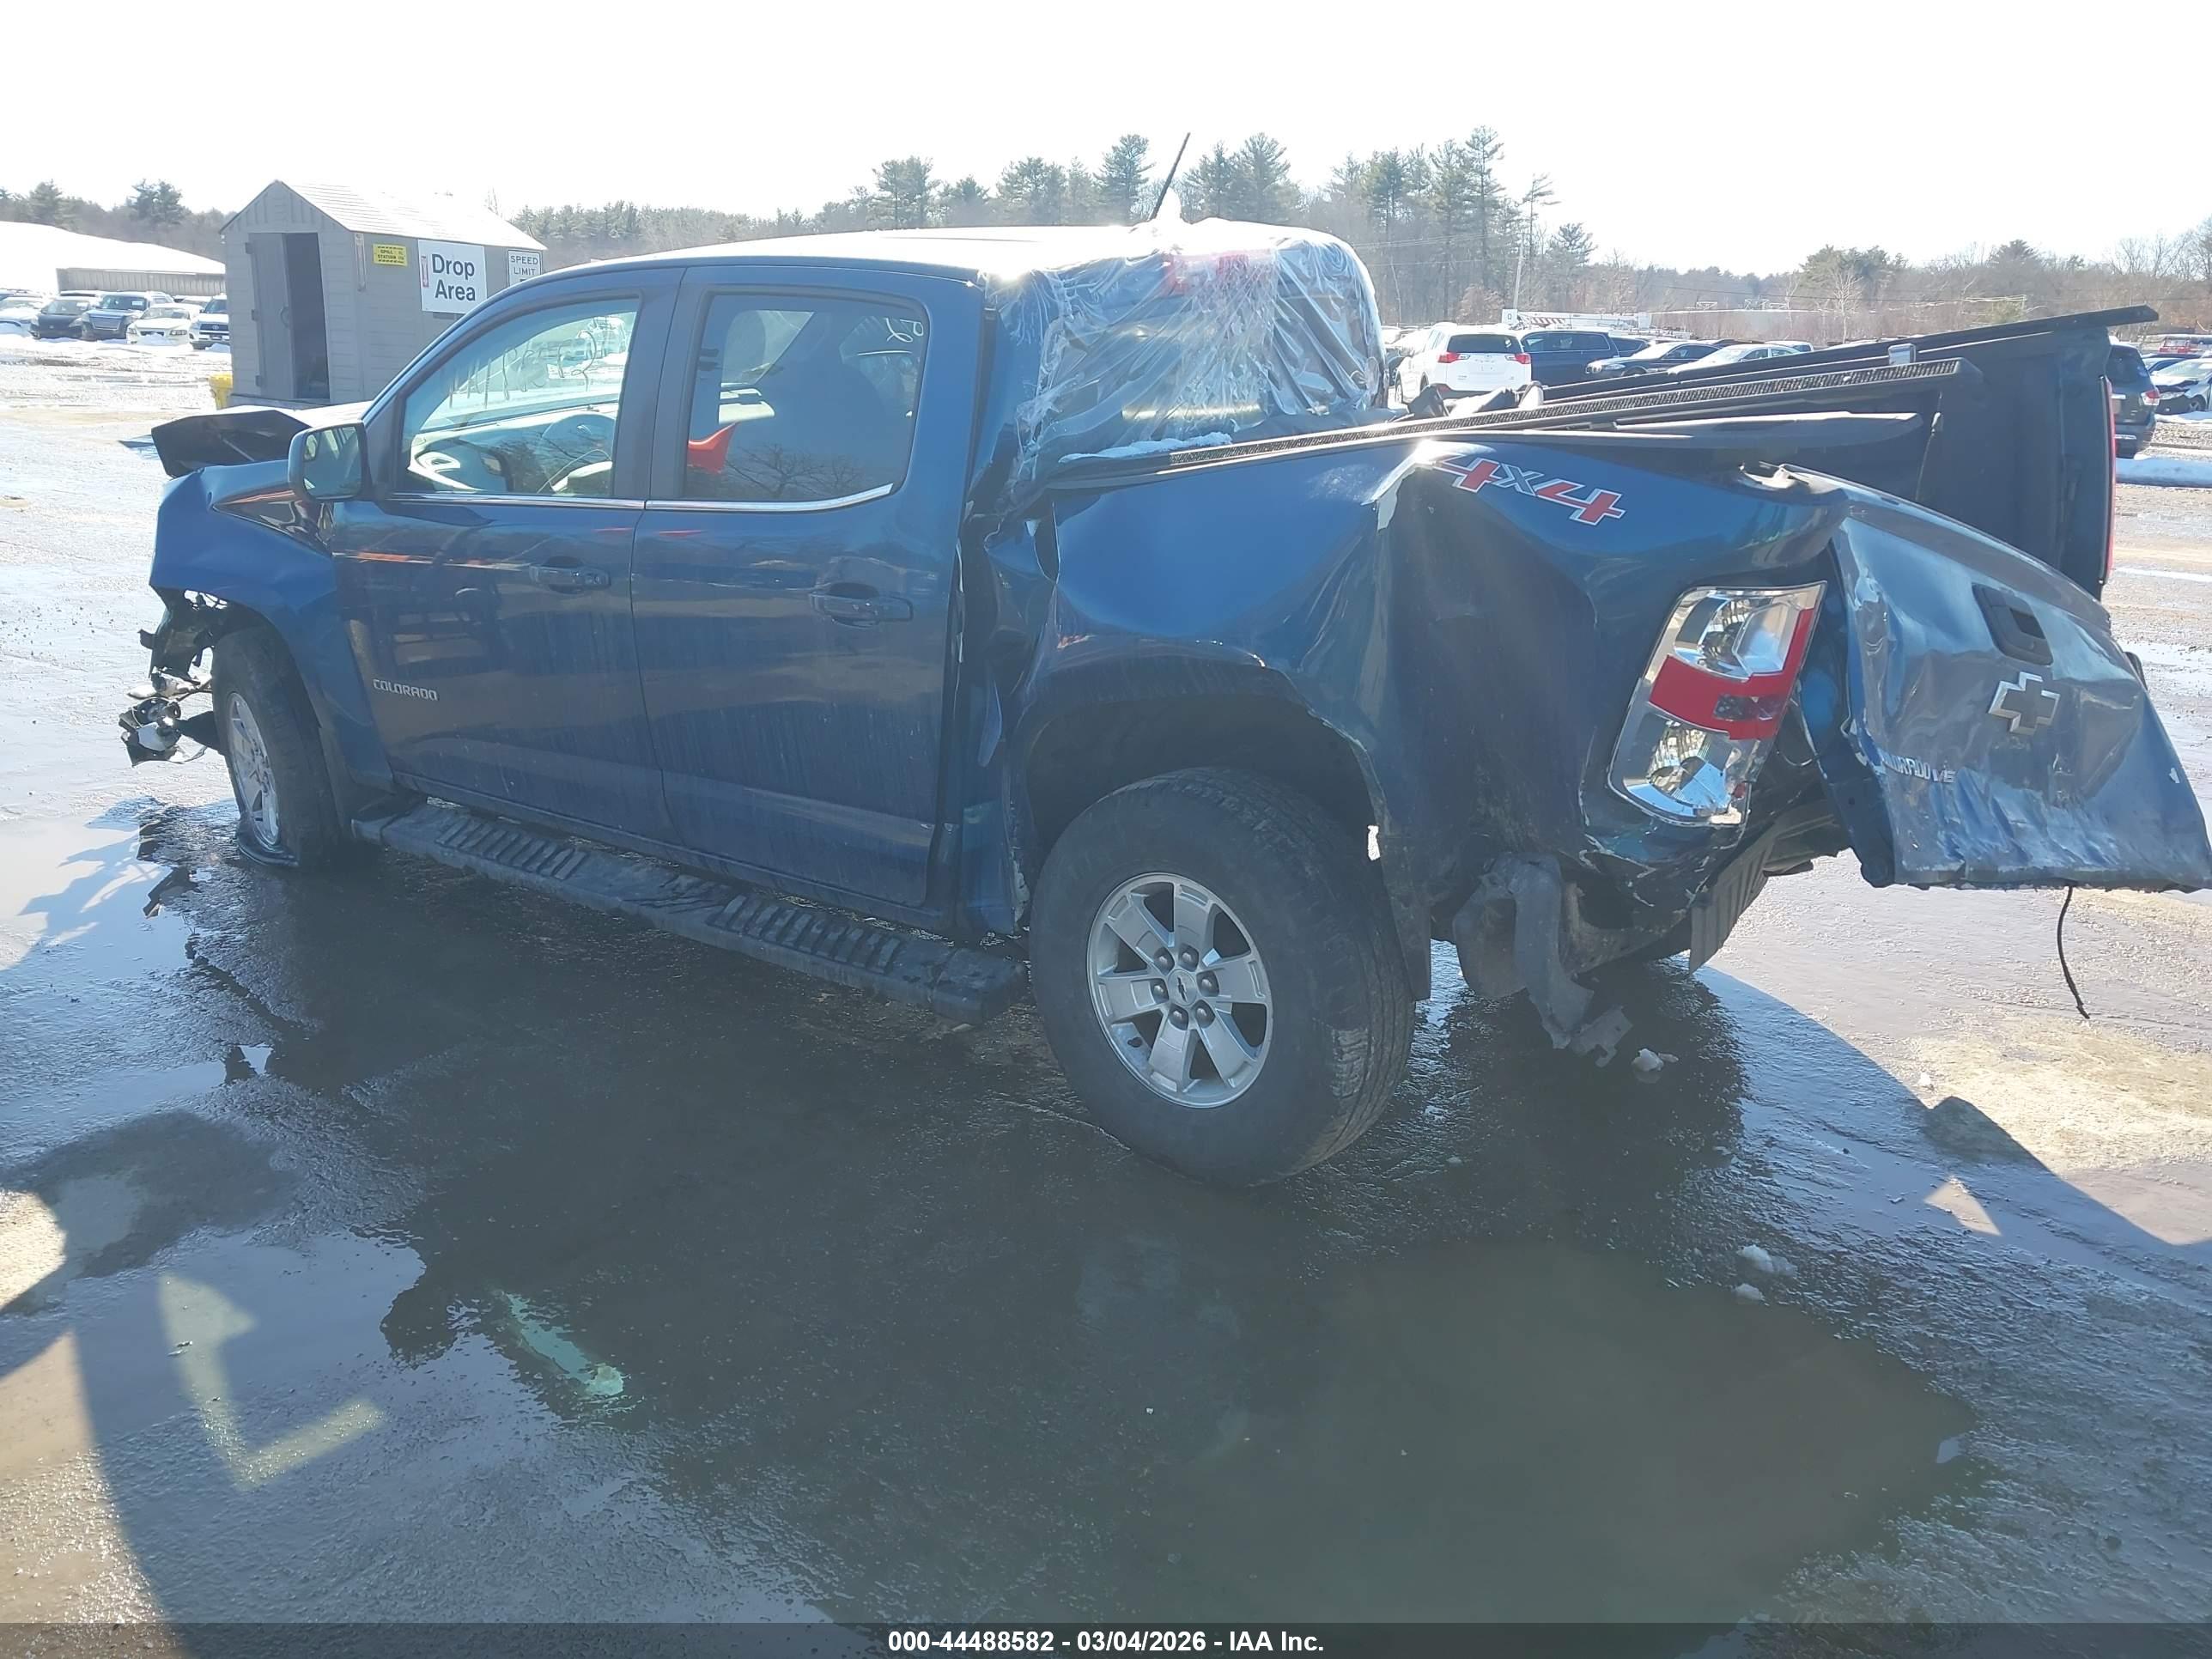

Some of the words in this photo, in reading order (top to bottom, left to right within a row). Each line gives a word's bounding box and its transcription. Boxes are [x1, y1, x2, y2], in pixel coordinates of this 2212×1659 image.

[432, 254, 475, 280] Drop
[511, 255, 538, 264] SPEED
[514, 267, 536, 276] LIMIT
[435, 279, 476, 301] Area
[373, 678, 438, 701] COLORADO
